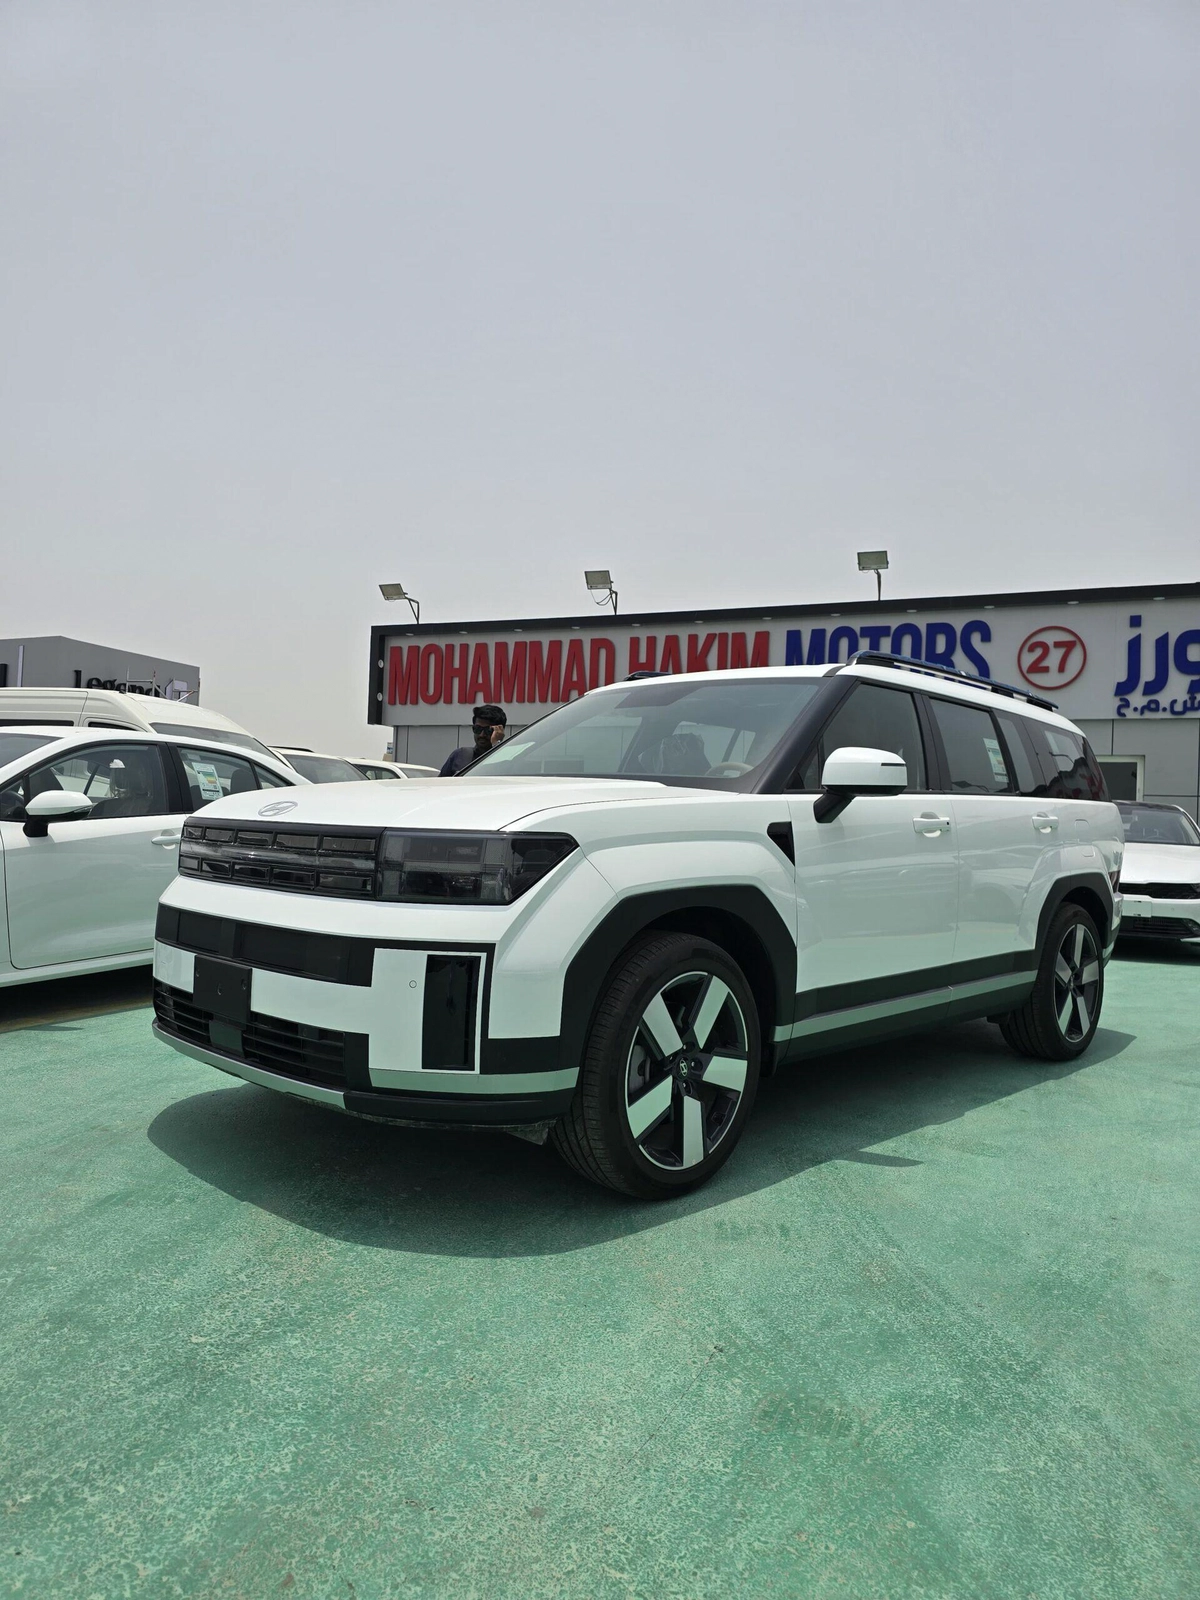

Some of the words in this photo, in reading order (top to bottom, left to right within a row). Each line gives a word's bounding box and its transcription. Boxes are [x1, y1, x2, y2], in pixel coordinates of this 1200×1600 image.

[388, 638, 616, 705] MOHAMMAD
[628, 630, 770, 674] HAKIM
[1026, 640, 1078, 674] 27
